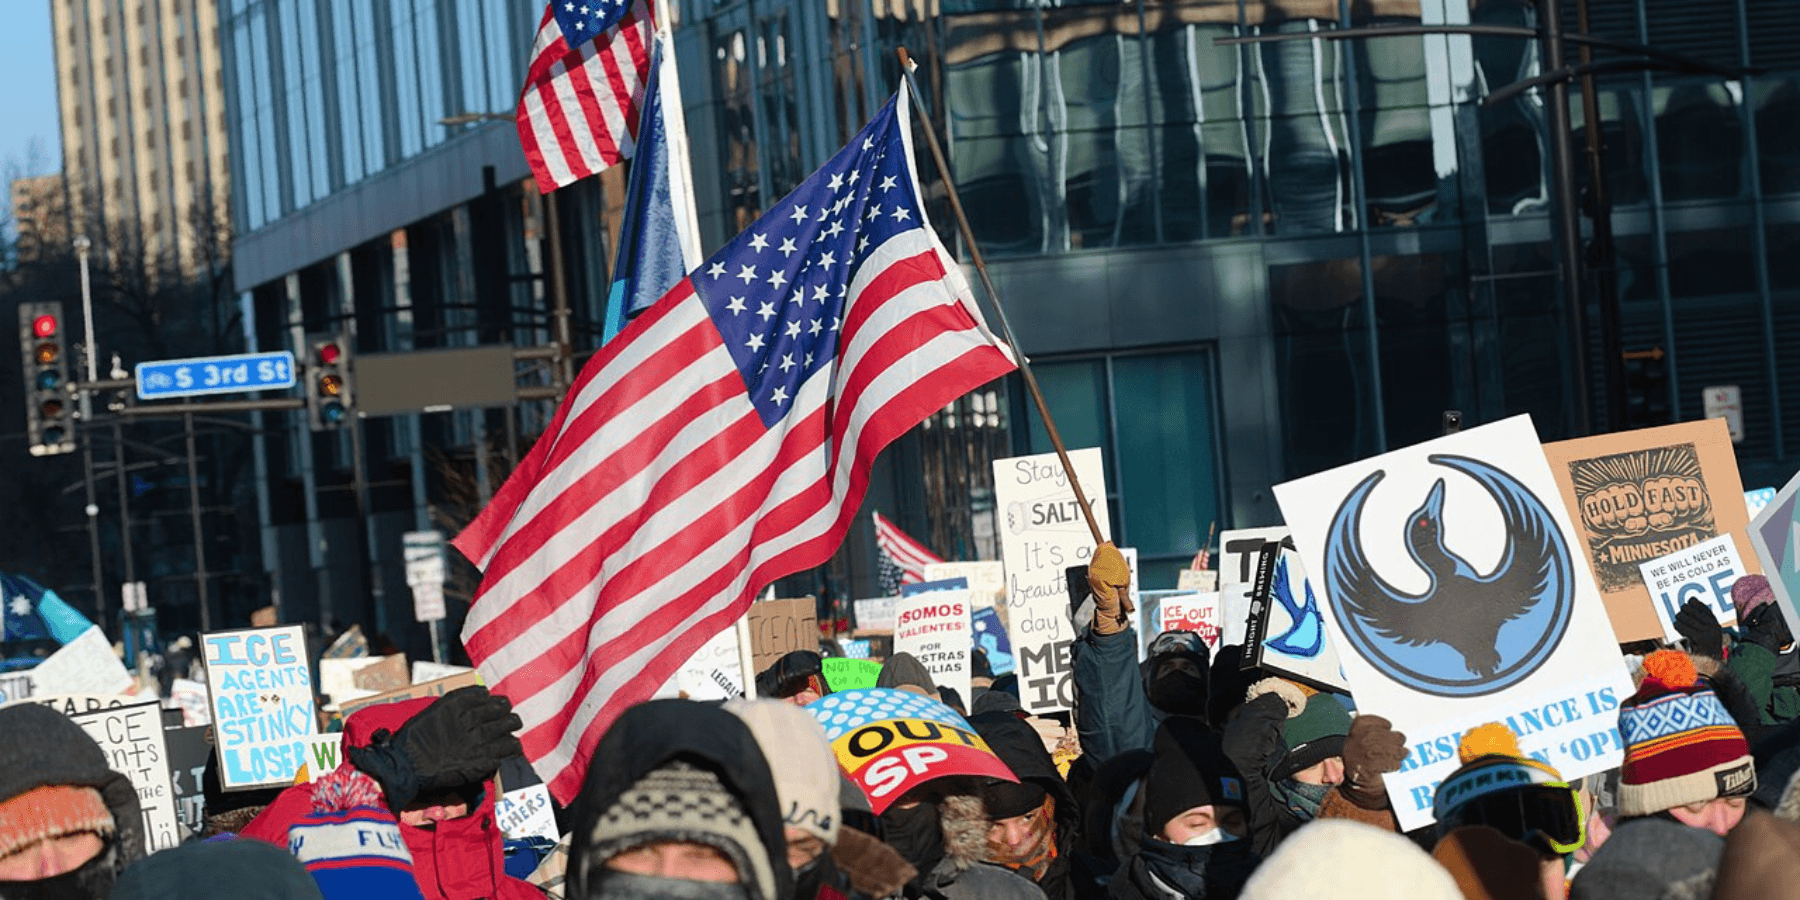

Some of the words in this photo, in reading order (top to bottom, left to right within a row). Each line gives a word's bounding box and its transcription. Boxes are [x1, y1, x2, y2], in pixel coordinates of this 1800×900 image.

[174, 366, 194, 389] S
[203, 362, 249, 385] 3rd
[257, 359, 288, 382] St
[1015, 460, 1067, 488] Stay
[1586, 491, 1640, 518] HOLD
[1647, 485, 1700, 506] FAST
[1024, 541, 1065, 572] It's
[1075, 545, 1093, 560] a
[1607, 531, 1700, 565] MINNESOTA
[1650, 566, 1668, 578] WE
[1667, 557, 1693, 573] WILL
[1692, 543, 1728, 564] NEVER
[1656, 577, 1671, 590] BE
[1673, 572, 1687, 584] AS
[1687, 562, 1715, 579] COLD
[1716, 555, 1731, 568] AS
[1245, 620, 1258, 659] INSIGHT
[1256, 551, 1269, 597] BREWING
[1660, 568, 1735, 623] ICE
[1020, 607, 1060, 641] day
[1163, 605, 1183, 618] ICE
[1188, 606, 1214, 621] OUT
[206, 633, 297, 667] ICE
[748, 615, 785, 657] ICE
[920, 643, 942, 651] POR
[221, 665, 310, 691] AGENTS
[217, 692, 264, 719] ARE
[1585, 686, 1619, 717] IS
[221, 697, 313, 746] STINKY
[848, 721, 976, 758] OUT
[224, 741, 308, 784] LOSER
[864, 745, 949, 798] SP
